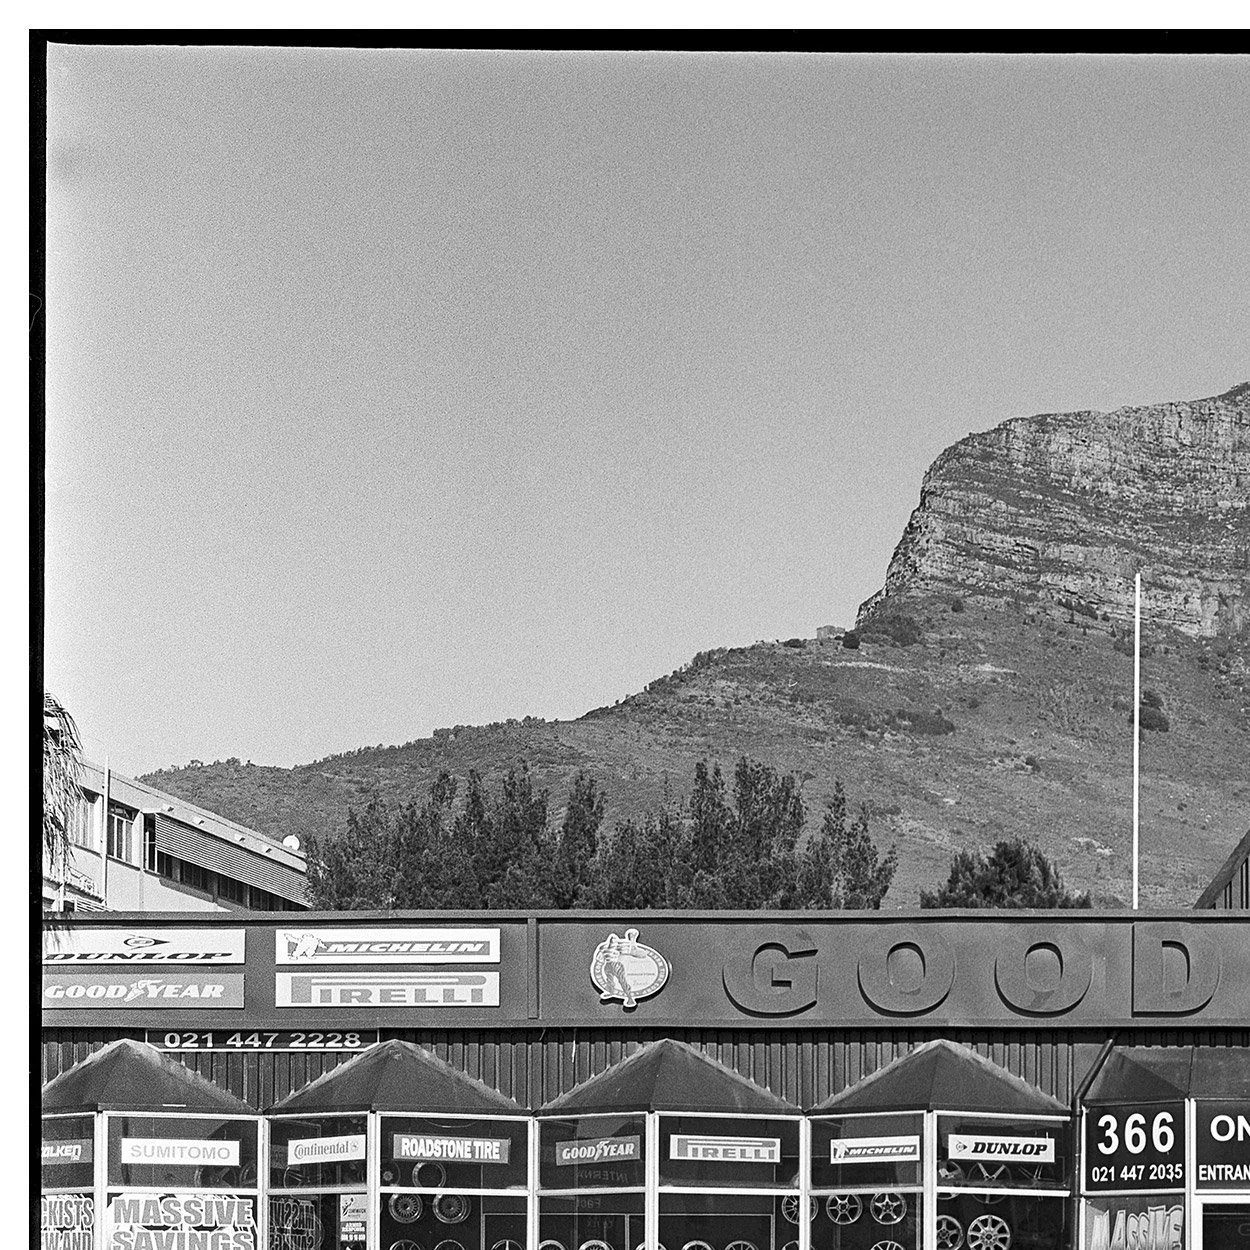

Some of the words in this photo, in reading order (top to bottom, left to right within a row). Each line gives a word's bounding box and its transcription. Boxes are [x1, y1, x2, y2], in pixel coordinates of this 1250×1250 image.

[44, 952, 233, 961] DUNLOP
[325, 940, 486, 954] MICHELIN
[44, 980, 225, 1000] GOODYEAR
[290, 975, 488, 1004] PIRELLI
[164, 1032, 213, 1049] 021
[227, 1032, 277, 1049] 447
[292, 1032, 362, 1049] 2228
[1097, 1111, 1175, 1155] 366
[130, 1144, 231, 1160] SUMITOMO
[294, 1140, 350, 1160] Continental
[401, 1137, 473, 1158] ROADSTONE
[473, 1141, 501, 1160] TIRE
[561, 1140, 635, 1161] GOODYEAR
[677, 1137, 777, 1160] PIRELLI
[849, 1145, 915, 1156] MICHELIN
[971, 1141, 1048, 1156] DUNLOP
[1091, 1166, 1115, 1182] 021
[1120, 1165, 1145, 1181] 447
[1149, 1163, 1183, 1181] 2035
[113, 1199, 253, 1226] MASSIVE
